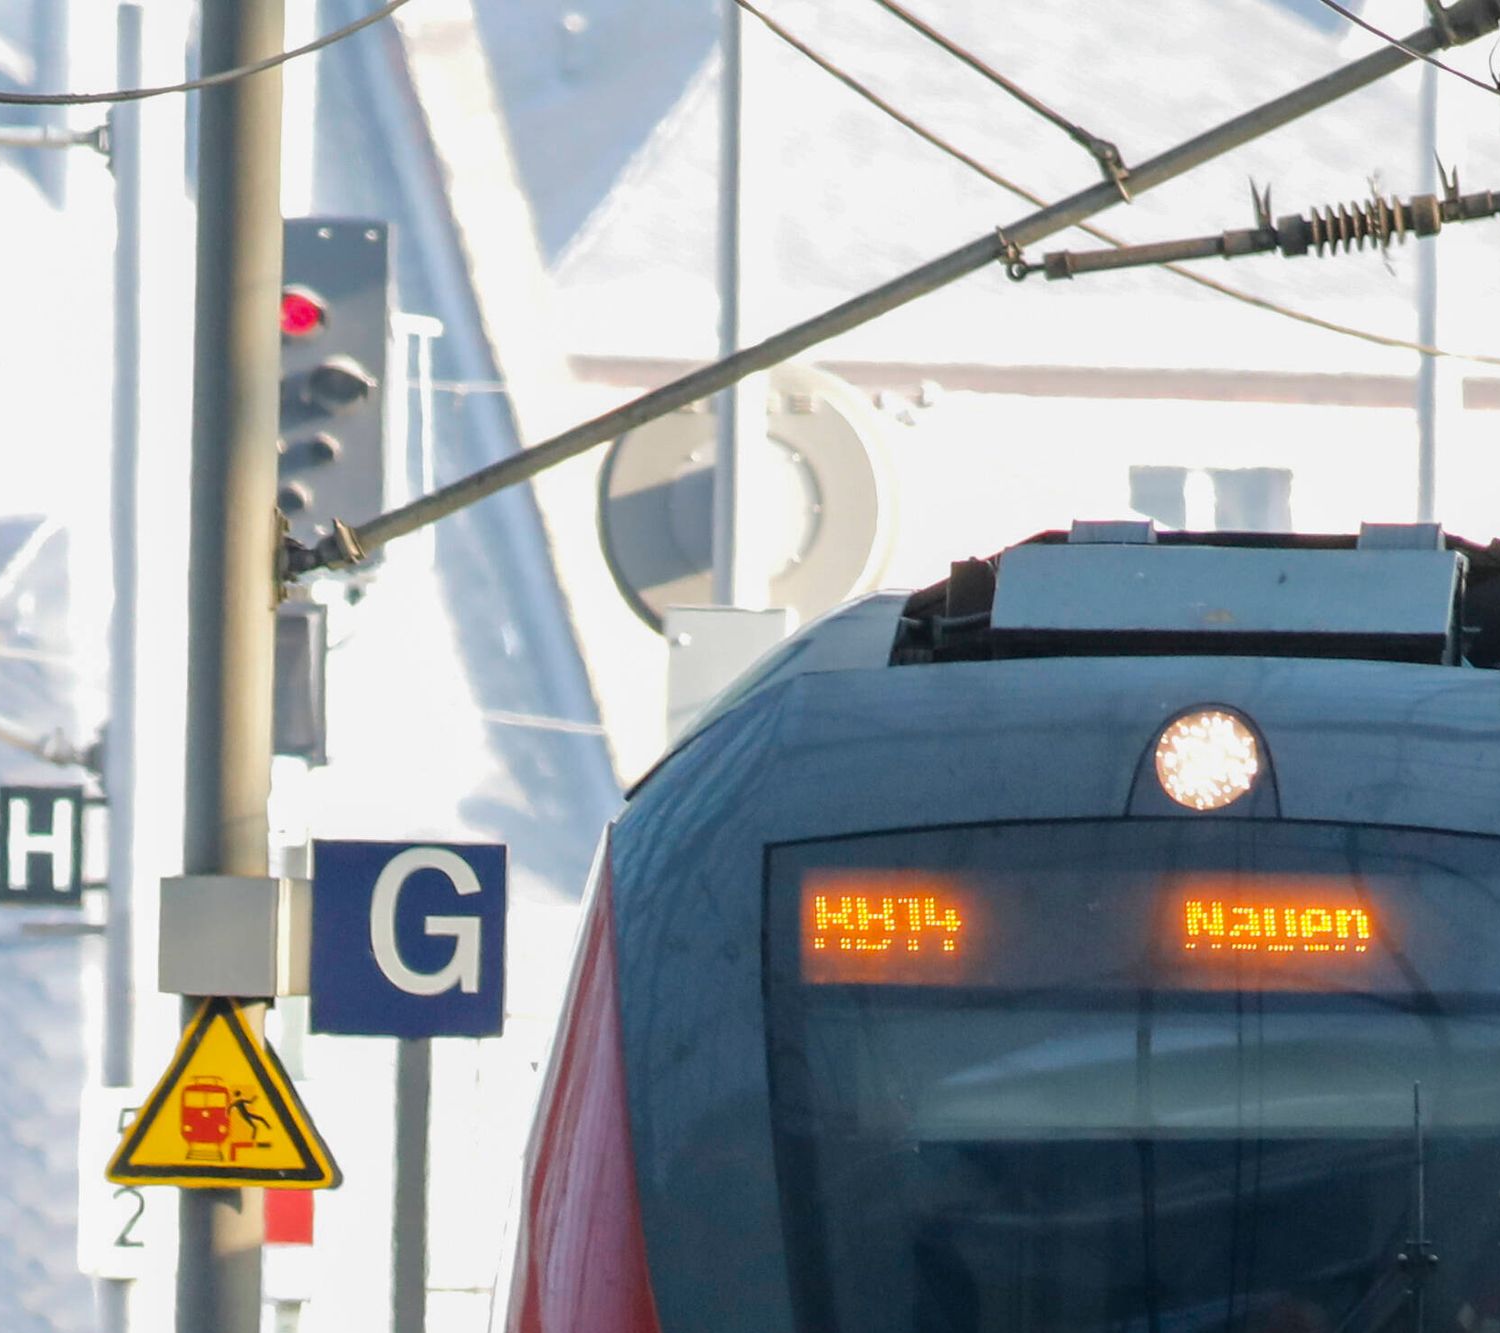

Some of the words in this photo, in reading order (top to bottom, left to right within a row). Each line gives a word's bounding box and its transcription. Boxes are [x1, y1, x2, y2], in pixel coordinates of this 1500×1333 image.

[7, 797, 74, 892] H
[369, 848, 482, 997] G
[1185, 901, 1370, 952] Nauen
